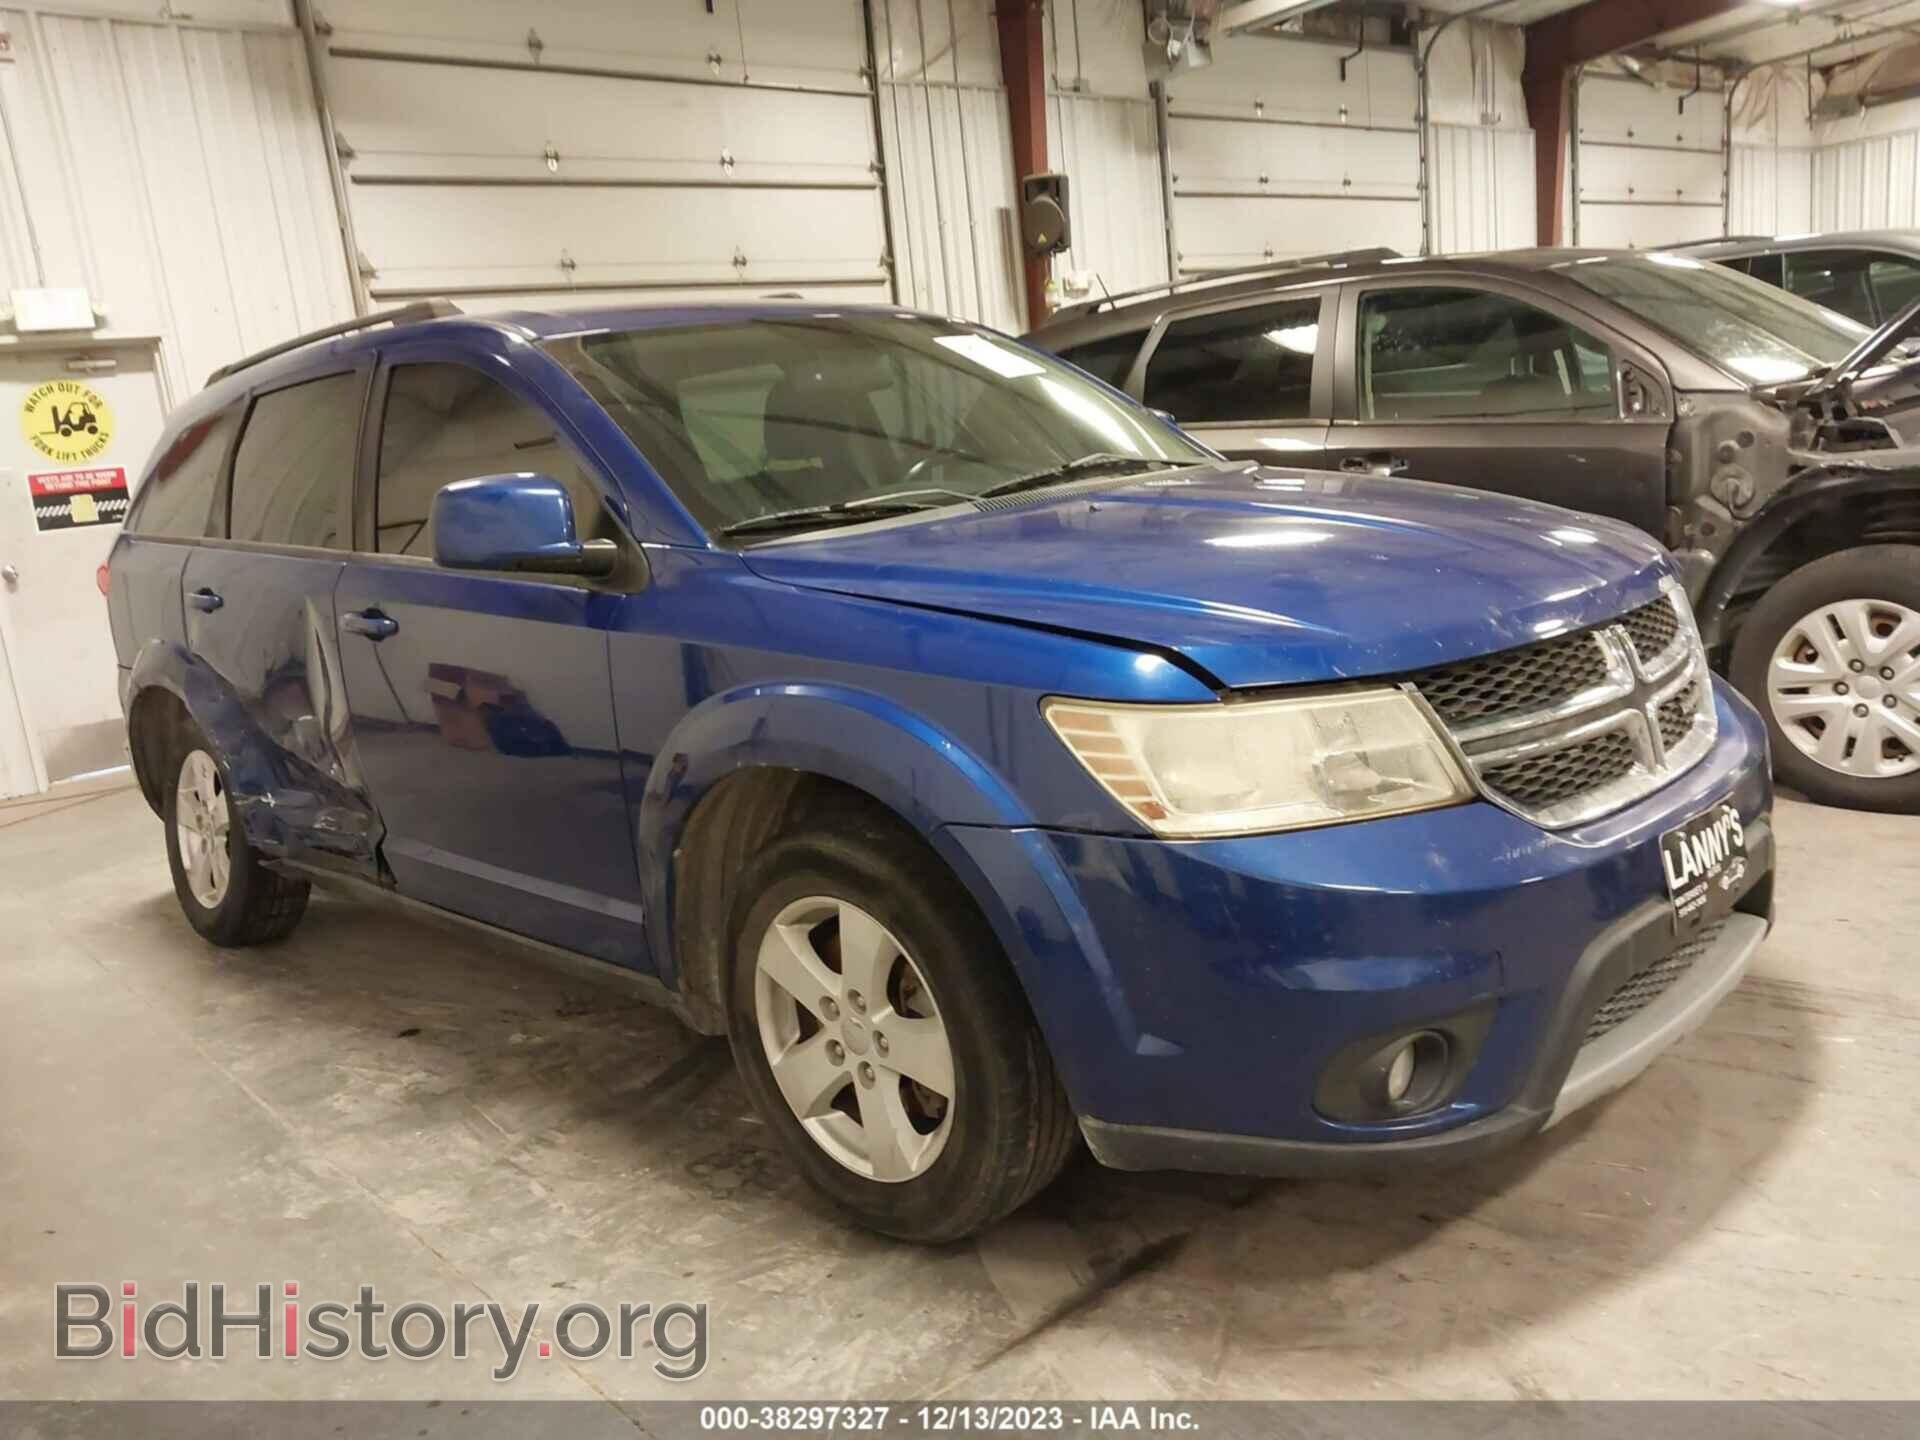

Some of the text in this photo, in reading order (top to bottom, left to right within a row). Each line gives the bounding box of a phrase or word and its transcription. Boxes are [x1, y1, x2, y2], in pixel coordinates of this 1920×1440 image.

[24, 383, 55, 413] WATCH
[57, 382, 80, 395] OUT
[56, 450, 78, 462] LIFT
[1663, 808, 1745, 890] LANNY'S
